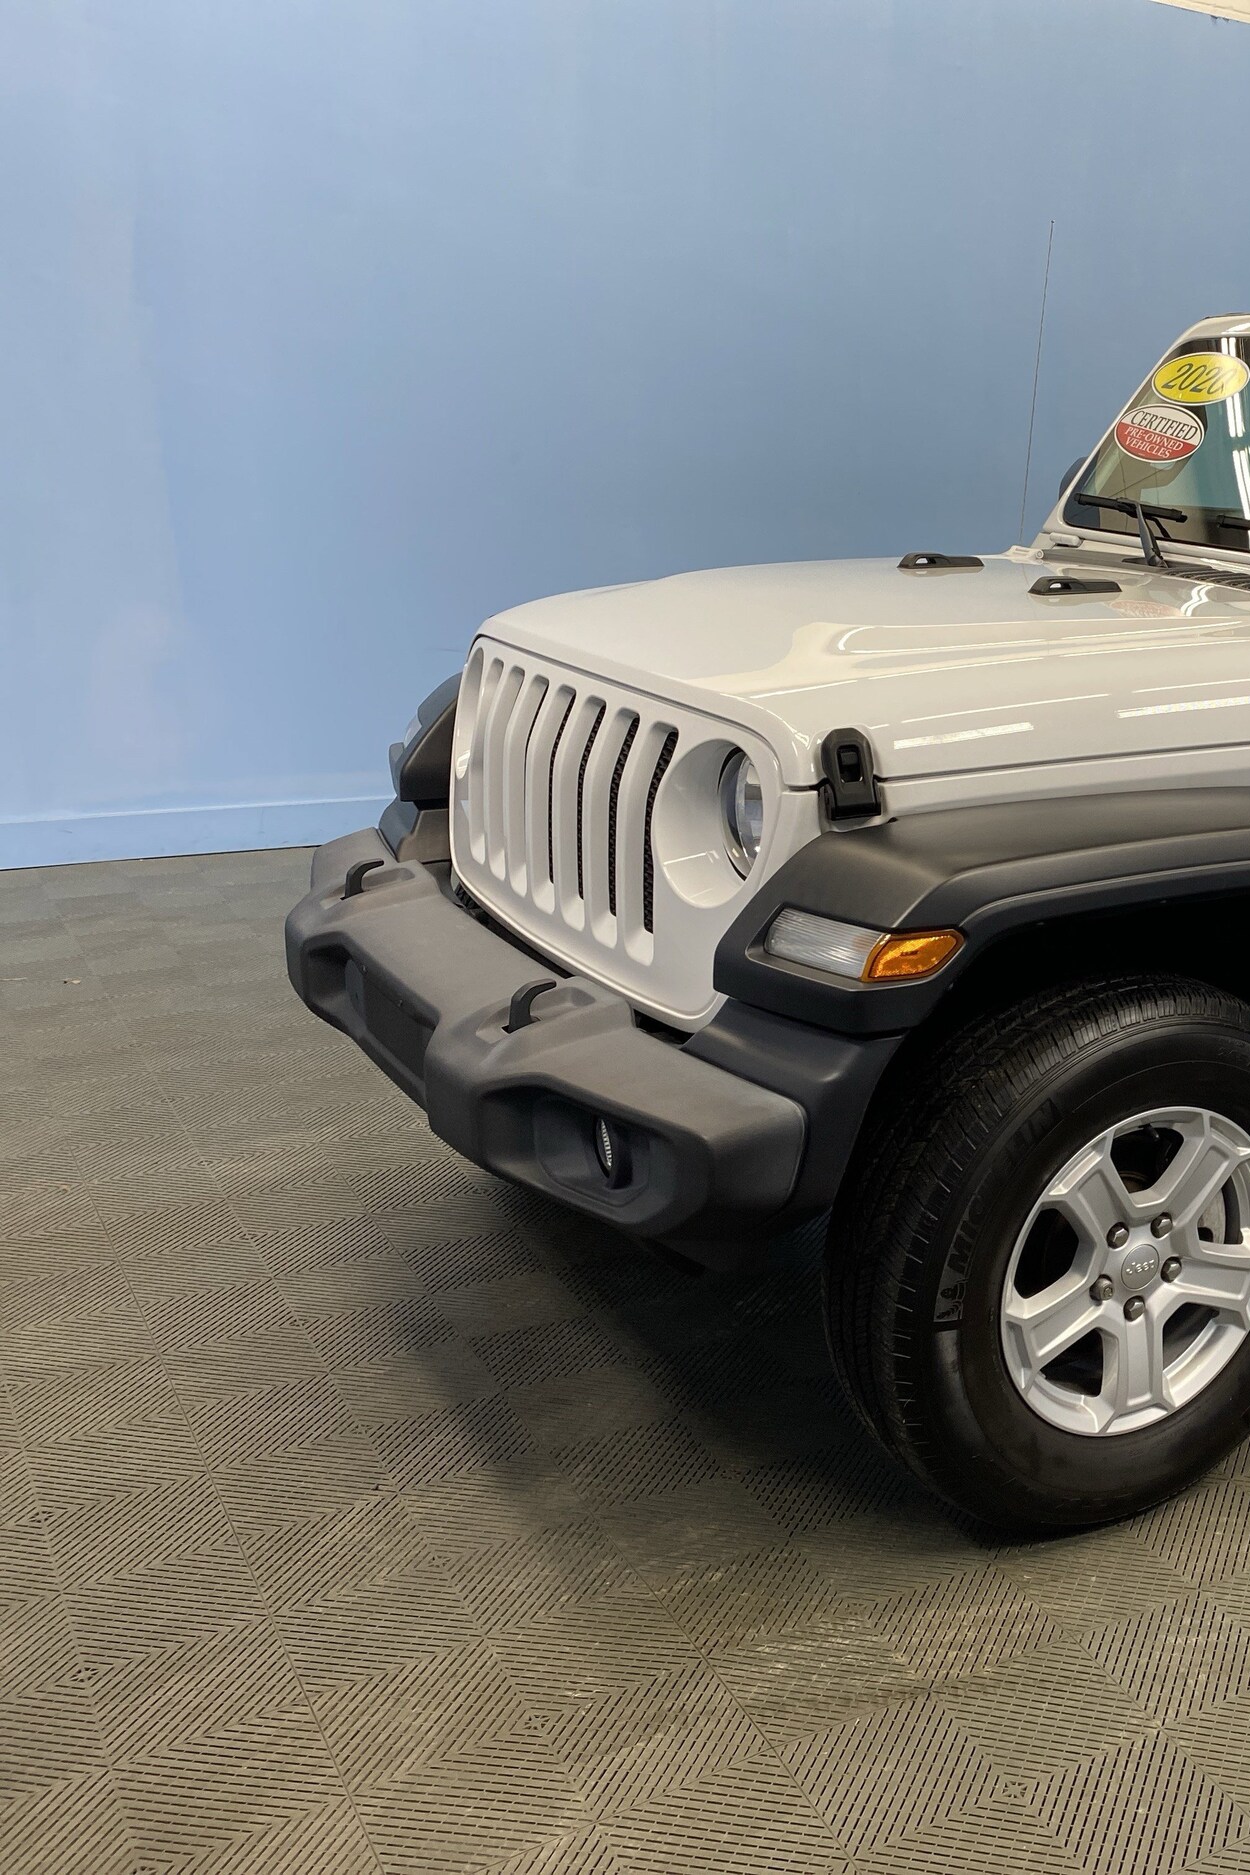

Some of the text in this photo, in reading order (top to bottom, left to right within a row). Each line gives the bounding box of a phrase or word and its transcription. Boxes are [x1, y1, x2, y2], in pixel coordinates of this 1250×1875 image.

[1131, 410, 1198, 441] CERTIFIED
[1125, 426, 1183, 451] PRE-OWNED
[1125, 436, 1172, 458] VEHICLES
